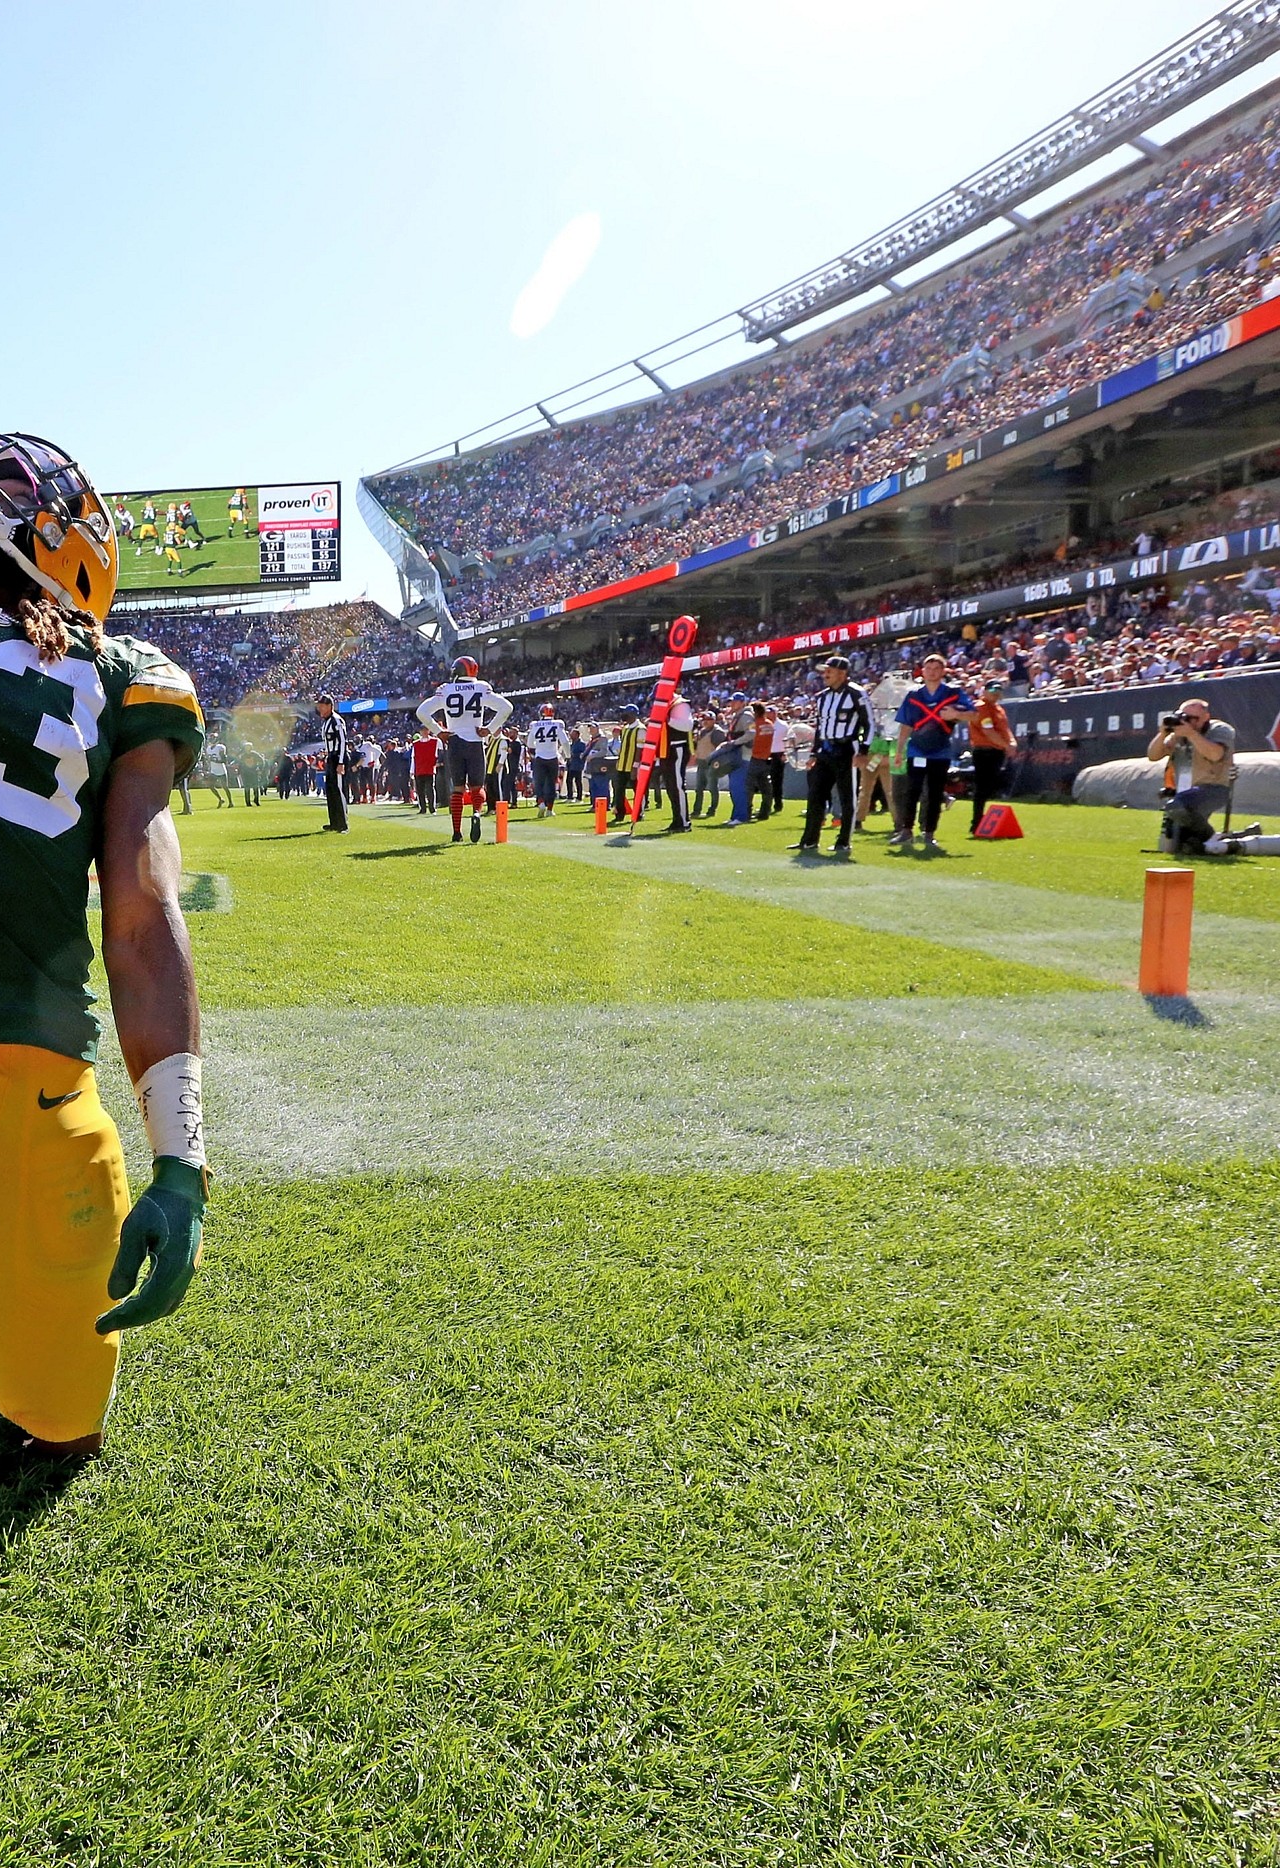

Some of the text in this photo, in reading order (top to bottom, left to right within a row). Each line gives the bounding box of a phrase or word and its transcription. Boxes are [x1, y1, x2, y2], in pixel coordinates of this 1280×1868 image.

[1174, 324, 1232, 370] FORD
[263, 496, 328, 512] proven IT
[840, 496, 849, 514] 7
[787, 516, 799, 535] 16
[266, 542, 280, 551] 121
[267, 553, 278, 561] 91
[266, 564, 280, 572] 212
[318, 562, 331, 570] 137
[1129, 561, 1139, 578] 4
[1140, 556, 1160, 576] INT
[732, 647, 742, 661] TB
[755, 644, 771, 658] Brady
[828, 629, 837, 642] 17
[600, 671, 619, 684] Regular
[620, 668, 637, 680] Season
[638, 666, 658, 679] Passing
[455, 684, 475, 692] QUINN
[445, 693, 483, 718] 94
[535, 725, 558, 742] 44
[981, 809, 1002, 835] G
